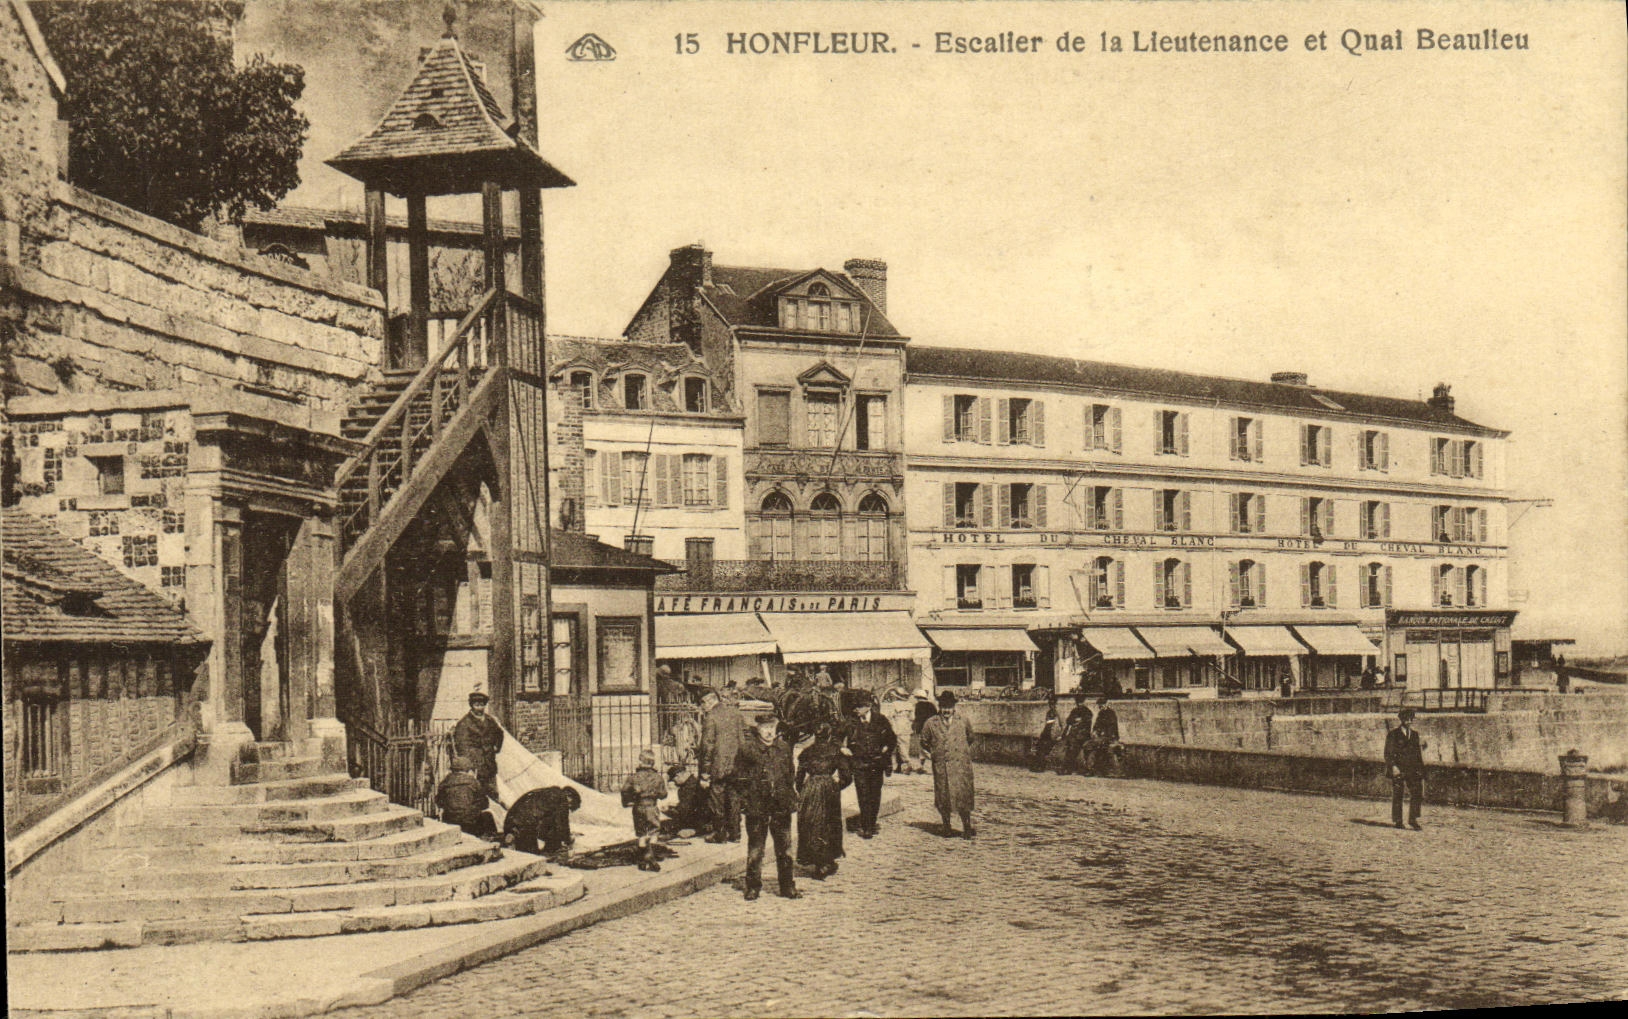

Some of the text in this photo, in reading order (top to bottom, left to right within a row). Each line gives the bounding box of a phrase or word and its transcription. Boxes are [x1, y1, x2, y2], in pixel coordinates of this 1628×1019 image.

[943, 533, 1215, 547] HOTEL DU CHEVAL BLANC
[1343, 541, 1359, 551] DU
[1380, 543, 1426, 554] CHEVAL
[1438, 546, 1482, 555] BLANC
[657, 595, 691, 611] AFÉ
[827, 596, 881, 611] PARIS
